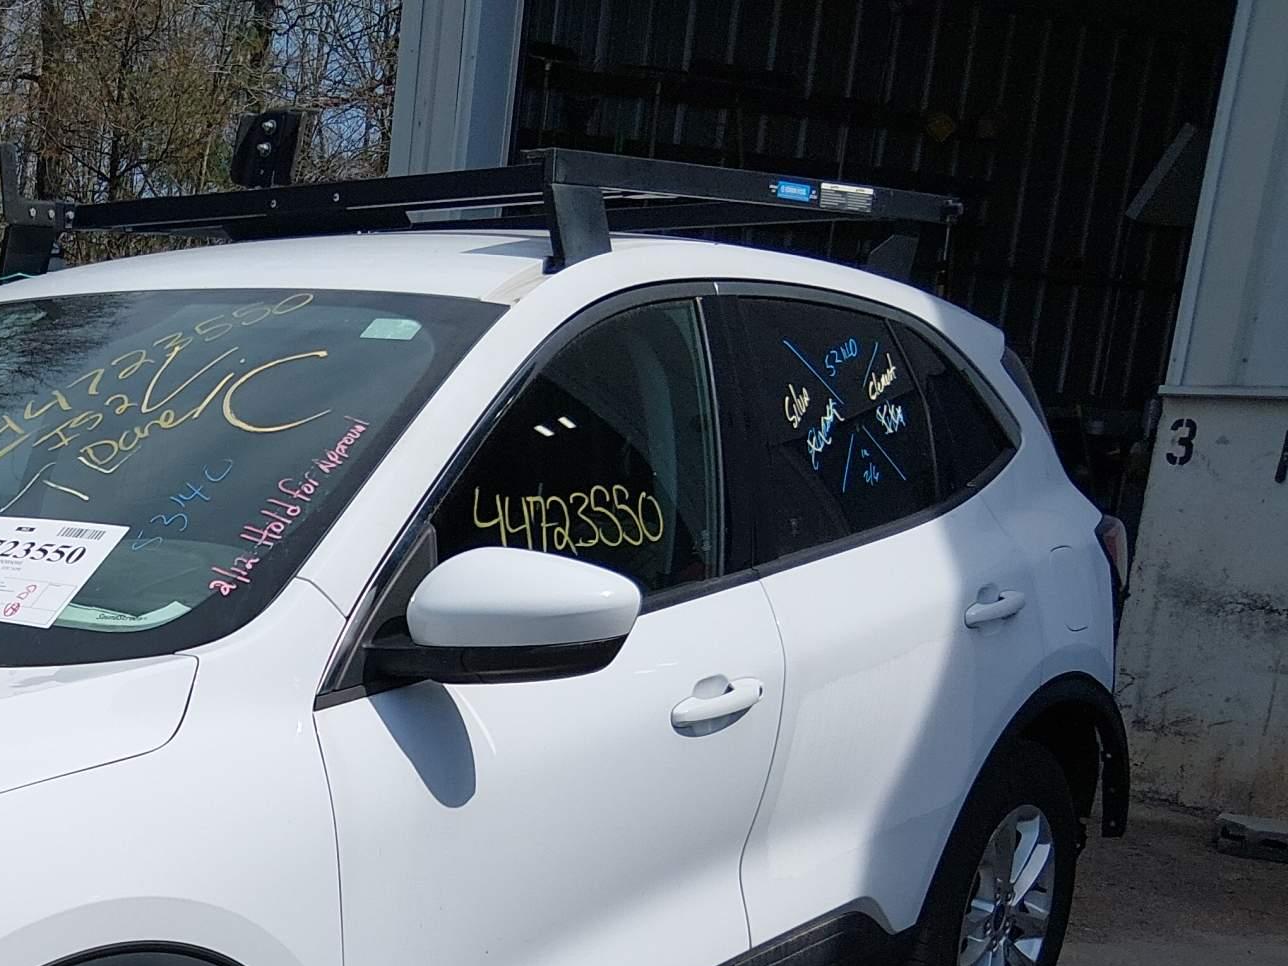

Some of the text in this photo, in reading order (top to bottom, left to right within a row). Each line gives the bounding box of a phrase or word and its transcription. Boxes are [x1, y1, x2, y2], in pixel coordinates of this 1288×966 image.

[1165, 418, 1198, 466] 3
[240, 498, 302, 549] Hold
[278, 473, 321, 503] for
[473, 484, 663, 556] 44723550
